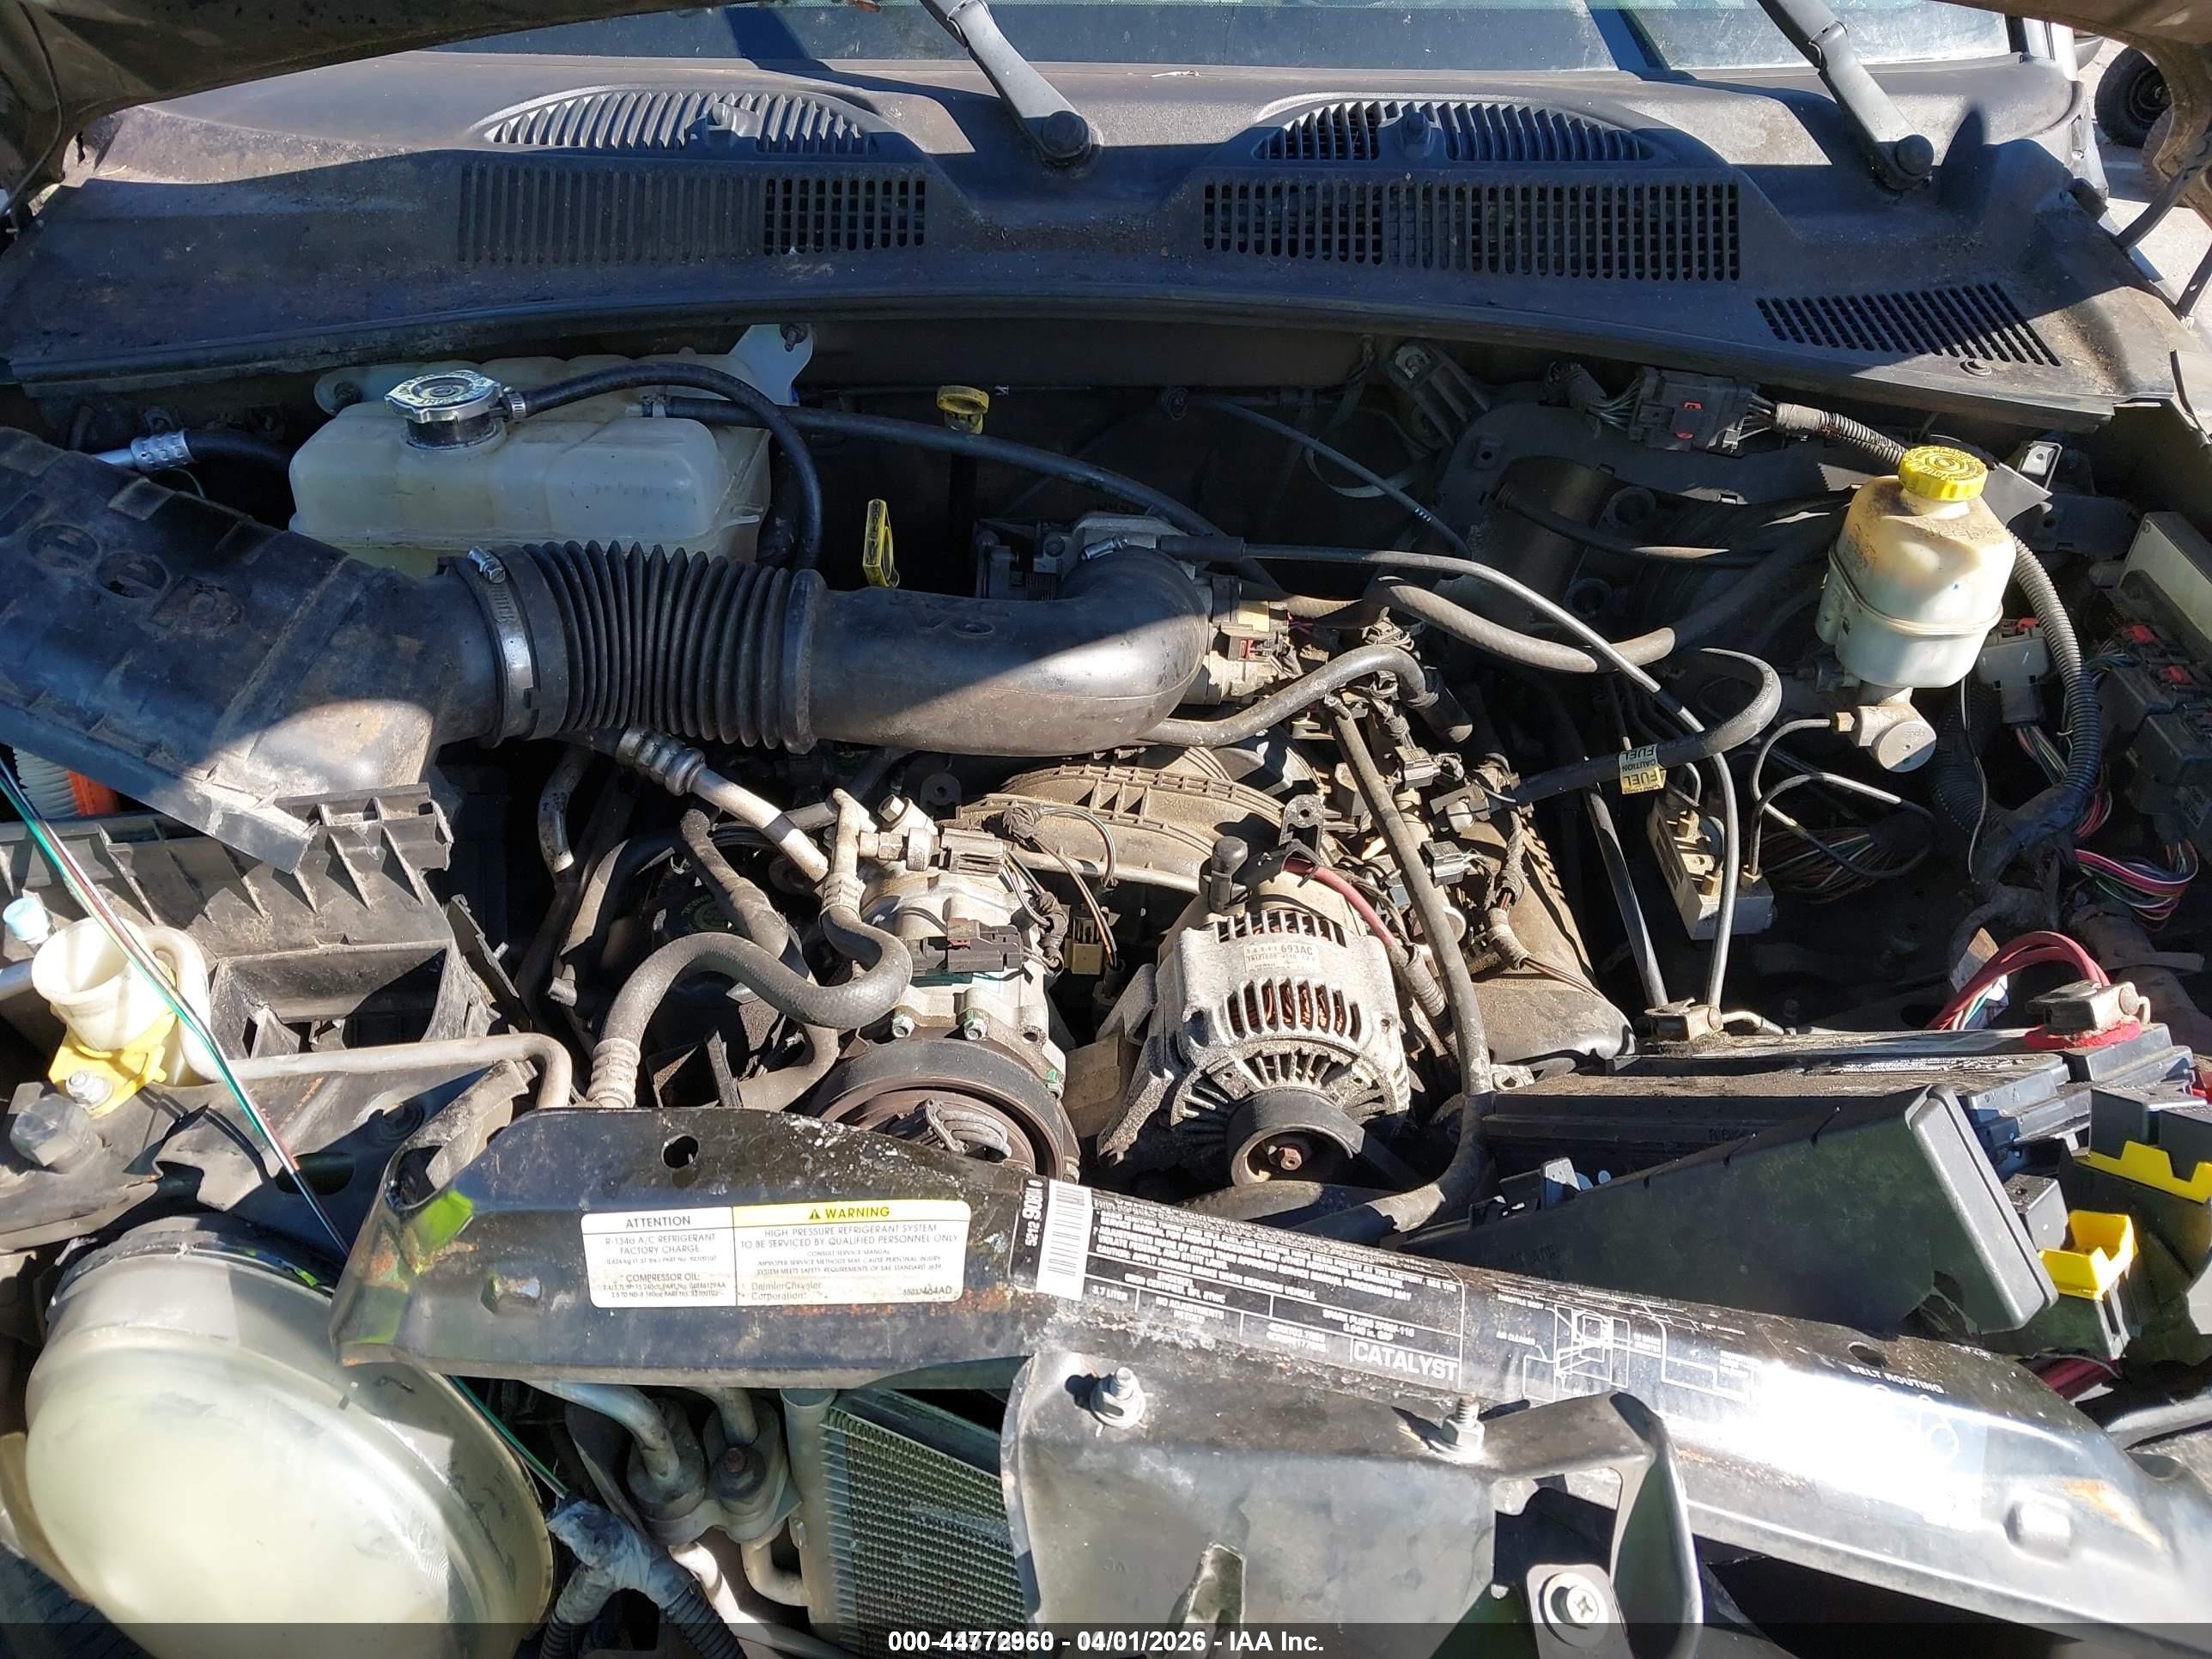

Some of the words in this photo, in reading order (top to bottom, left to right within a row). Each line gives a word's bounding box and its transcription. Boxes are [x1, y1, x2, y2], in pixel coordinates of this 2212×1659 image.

[1622, 746, 1655, 761] FUEL
[1622, 759, 1656, 772] CAUTION
[1622, 771, 1658, 787] FUEL
[825, 1206, 890, 1219] WARNING
[626, 1215, 691, 1229] ATTENTION
[764, 1229, 787, 1237] HIGH
[793, 1227, 834, 1236] PRESSURE
[838, 1225, 899, 1235] REFRIGERANT
[902, 1224, 937, 1232] SYSTEM
[638, 1236, 654, 1244] A/C
[658, 1233, 715, 1243] REFRIGERANT
[756, 1240, 765, 1249] BE
[769, 1238, 811, 1248] SERVICED
[814, 1237, 824, 1245] BY
[829, 1236, 875, 1245] QUALIFIED
[878, 1235, 930, 1243] PERSONNEL
[934, 1233, 957, 1242] ONLY
[620, 1246, 659, 1255] FACTORY
[626, 1273, 683, 1283] COMPRESSOR
[1353, 1341, 1458, 1382] CATALYST
[1847, 1364, 1881, 1379] BELT
[1884, 1372, 1945, 1394] ROUTING
